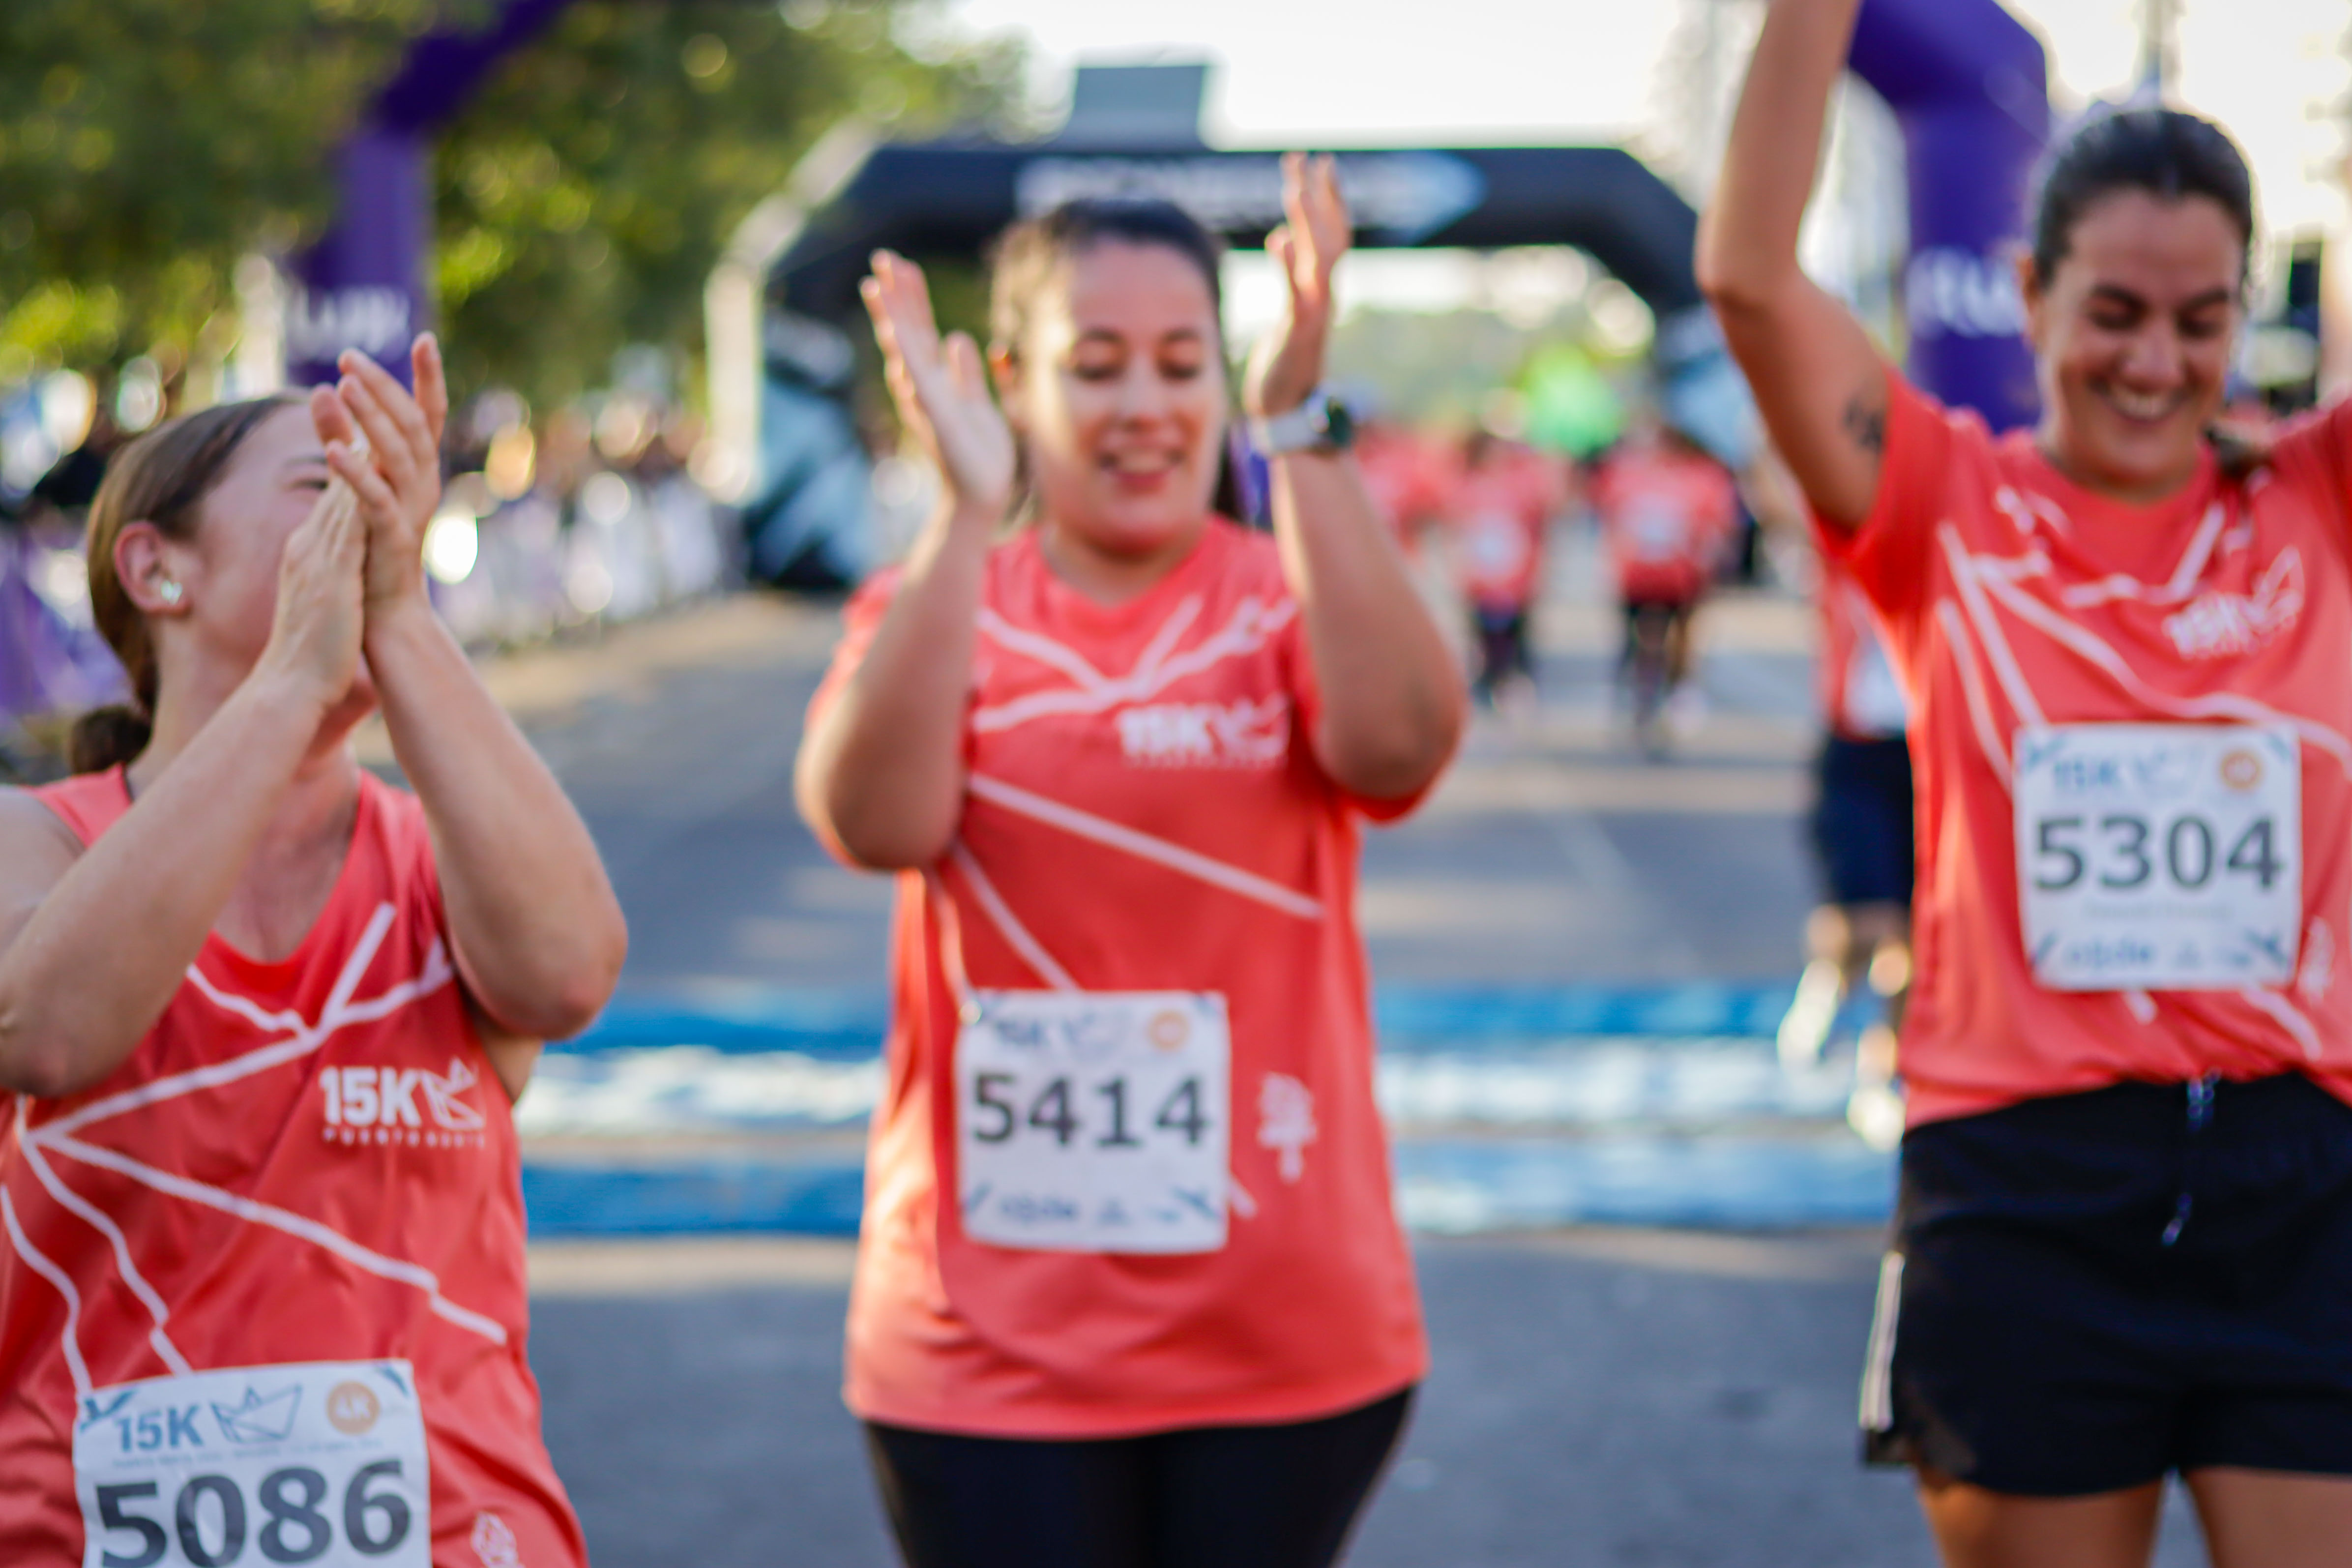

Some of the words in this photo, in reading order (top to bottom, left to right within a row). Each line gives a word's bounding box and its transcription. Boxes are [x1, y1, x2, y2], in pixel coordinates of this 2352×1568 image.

[2035, 814, 2284, 889] 5304
[319, 1065, 422, 1127] 15K
[972, 1071, 1211, 1148] 5414
[113, 1404, 205, 1453] 15K
[96, 1459, 412, 1568] 5086
